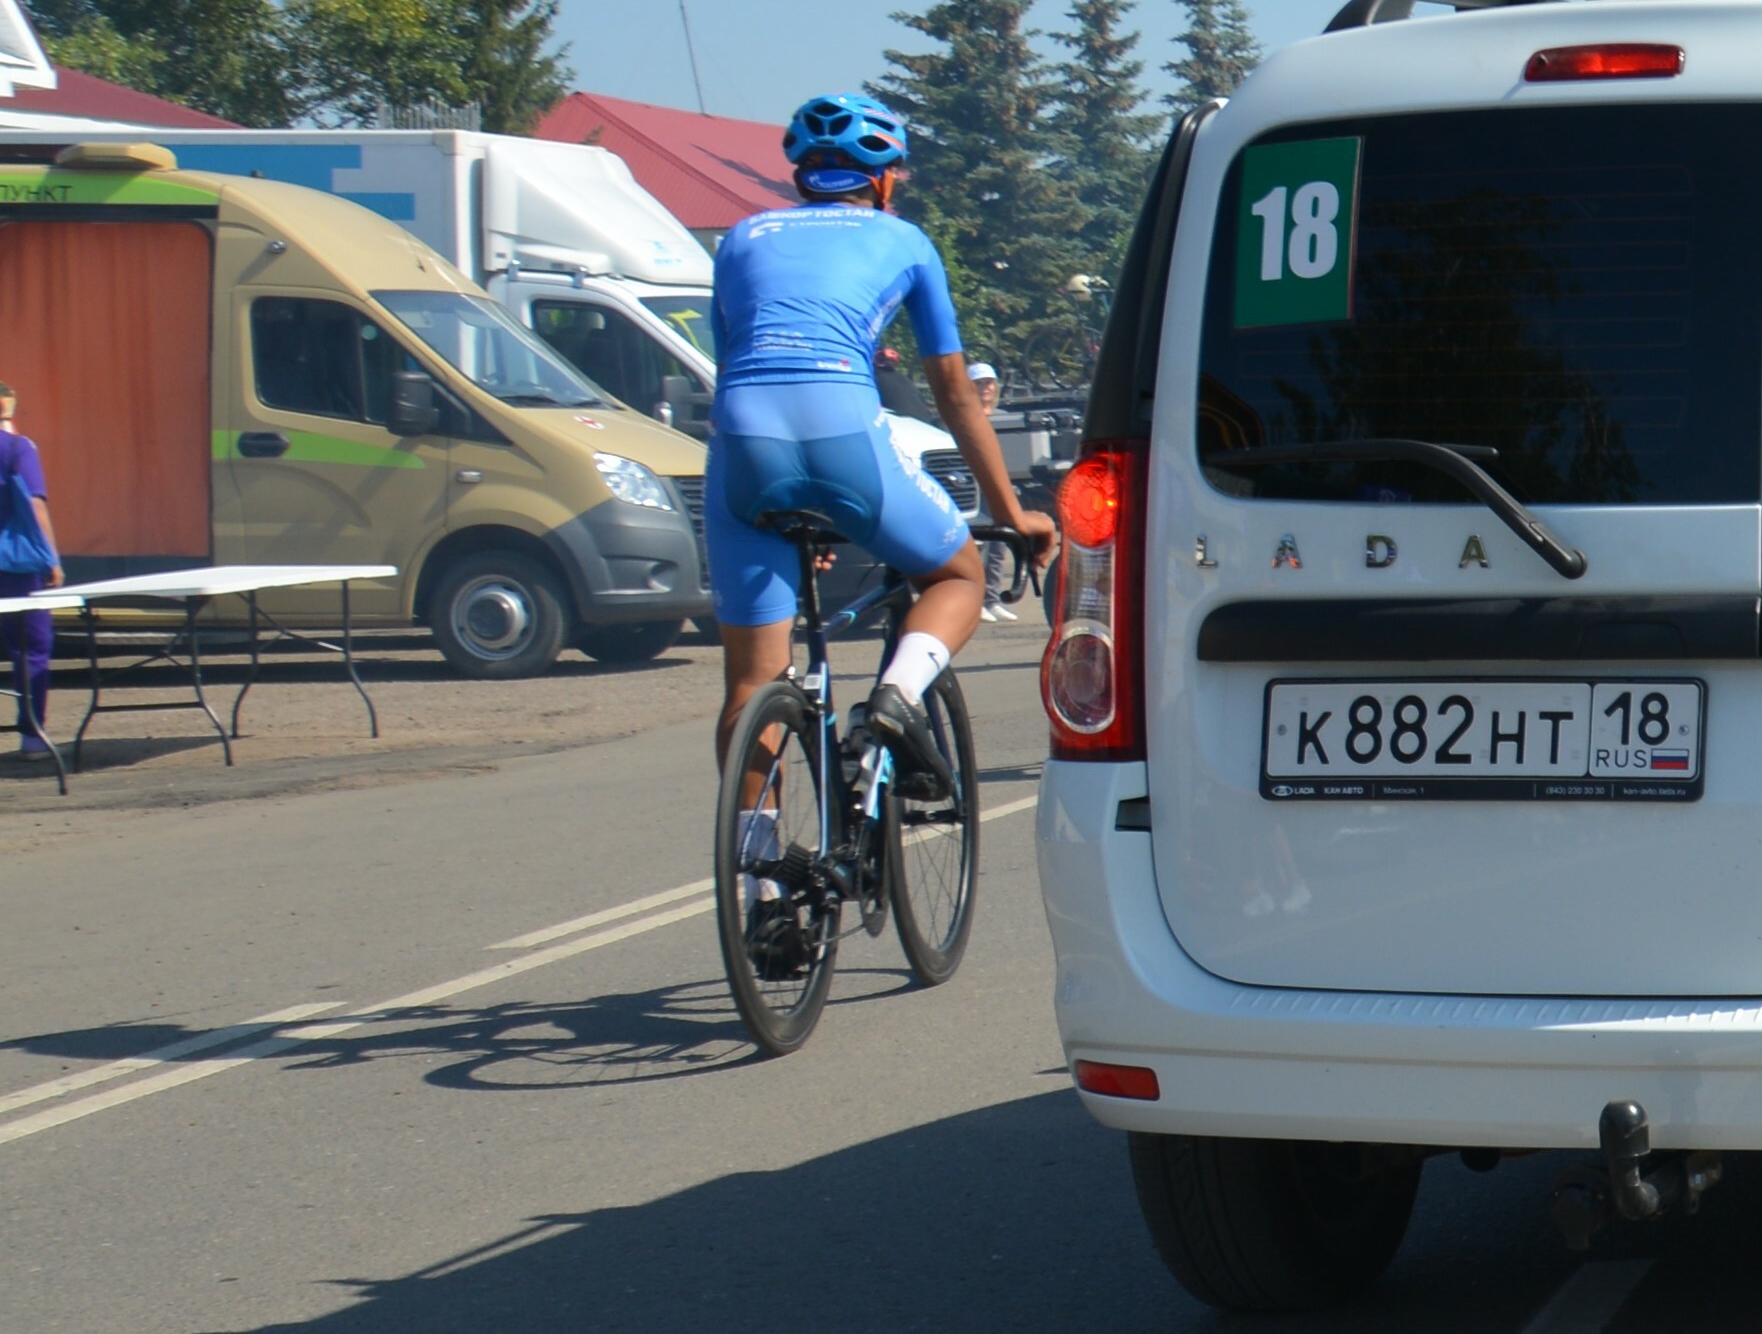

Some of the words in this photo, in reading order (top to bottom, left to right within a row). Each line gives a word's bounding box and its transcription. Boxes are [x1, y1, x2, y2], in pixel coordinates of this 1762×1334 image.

[1251, 181, 1339, 281] 18
[1196, 533, 1491, 568] LADA
[1604, 691, 1670, 745] 18
[1596, 749, 1648, 768] RUS
[1294, 786, 1315, 795] LADA
